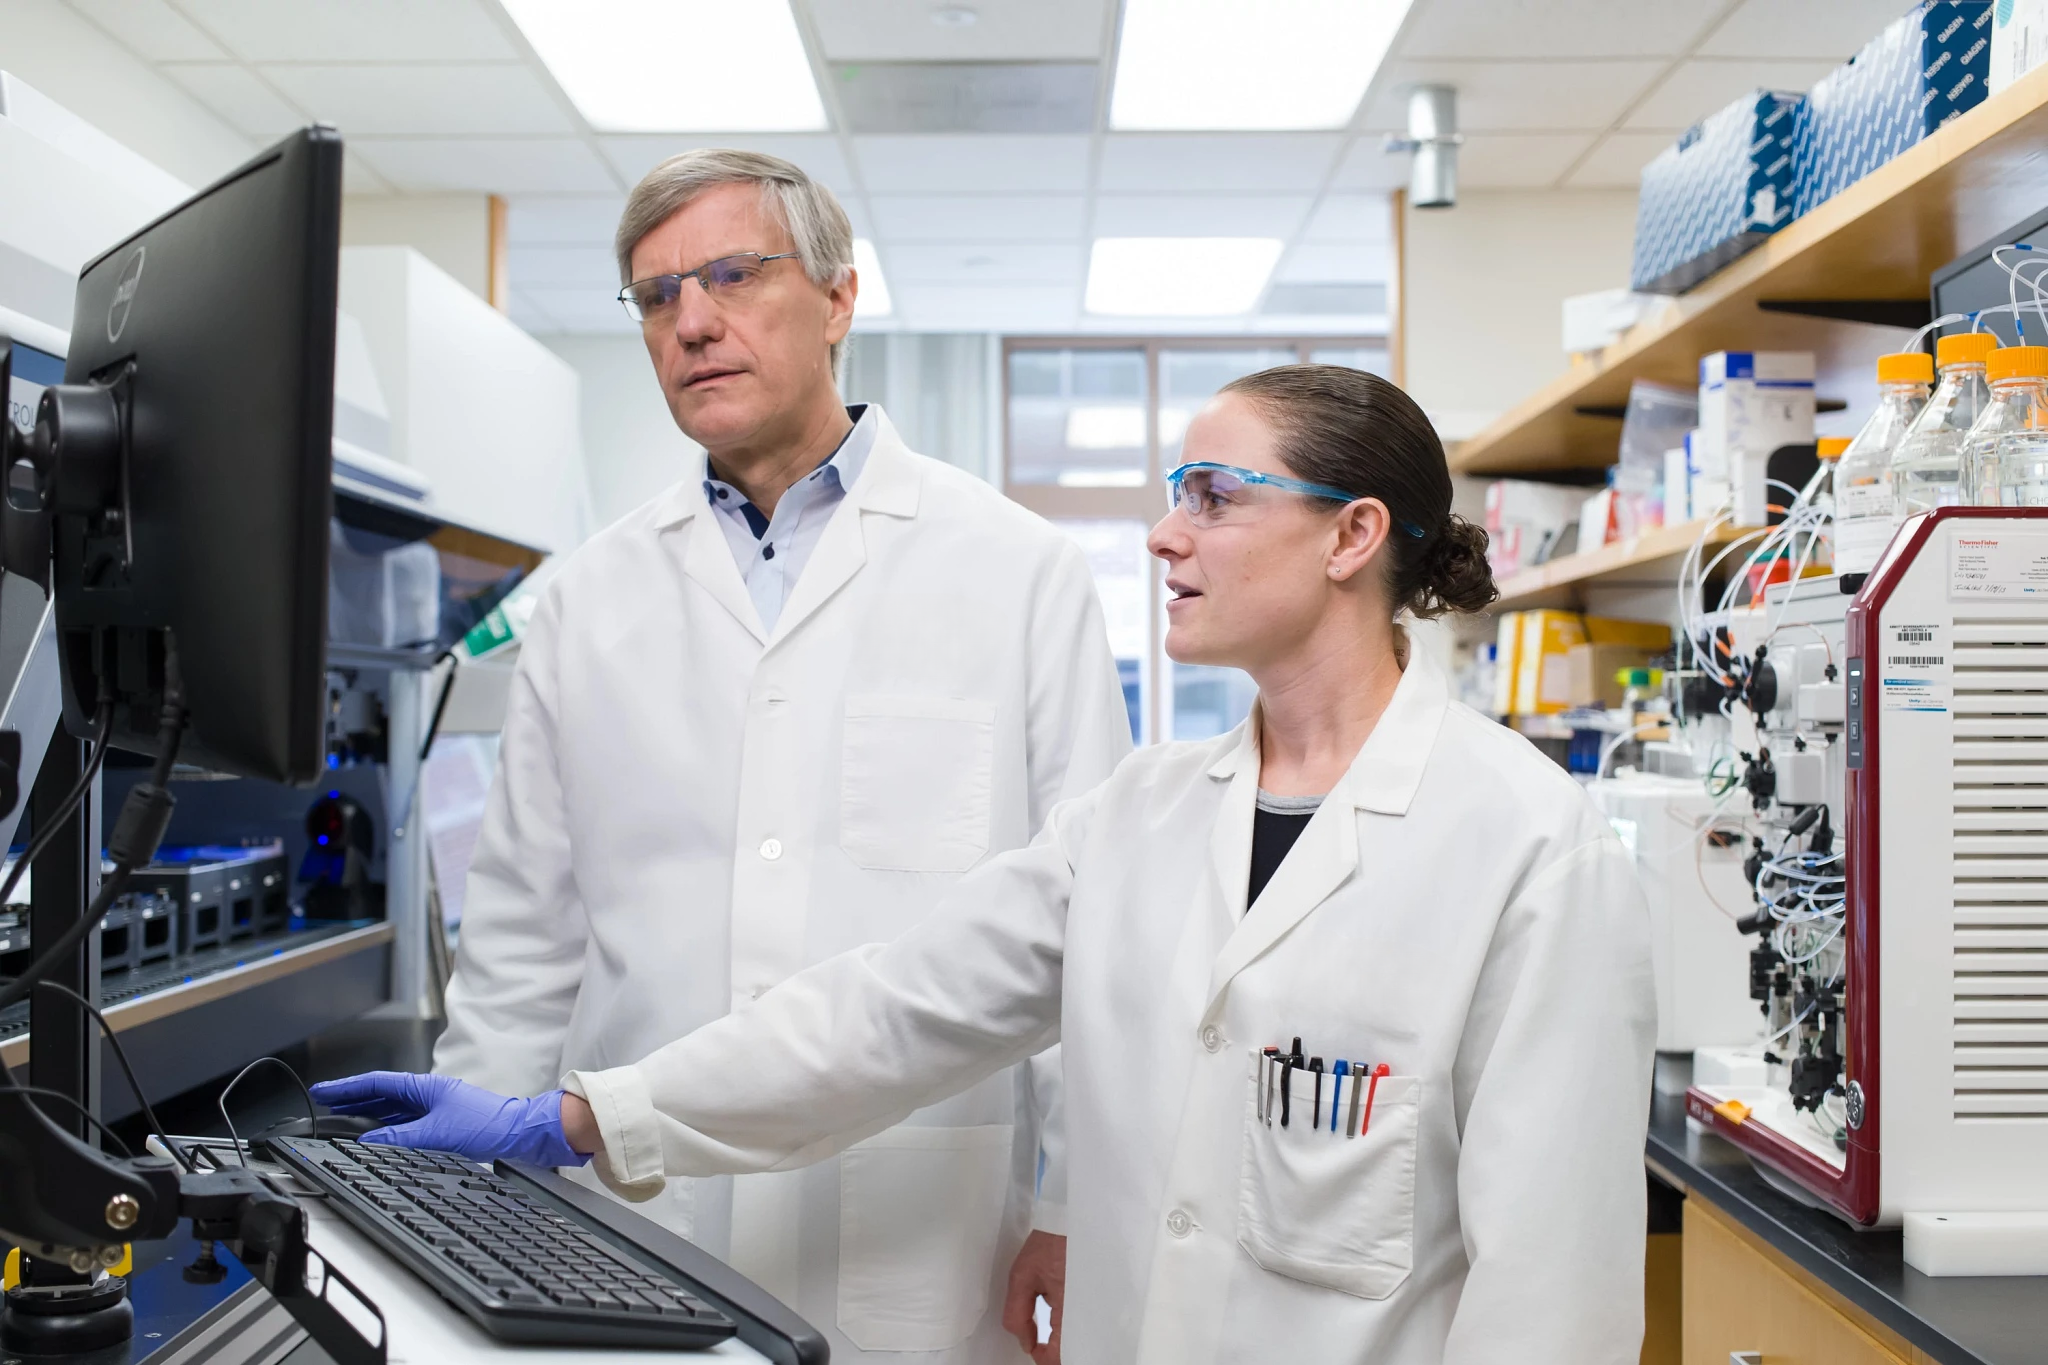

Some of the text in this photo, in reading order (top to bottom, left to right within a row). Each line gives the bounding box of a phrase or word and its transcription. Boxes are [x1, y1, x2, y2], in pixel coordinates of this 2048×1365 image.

[1937, 15, 1965, 43] QIAGEN
[1960, 37, 1988, 65] QIAGEN
[1923, 51, 1952, 80] QIAGEN
[1946, 73, 1975, 102] QIAGEN
